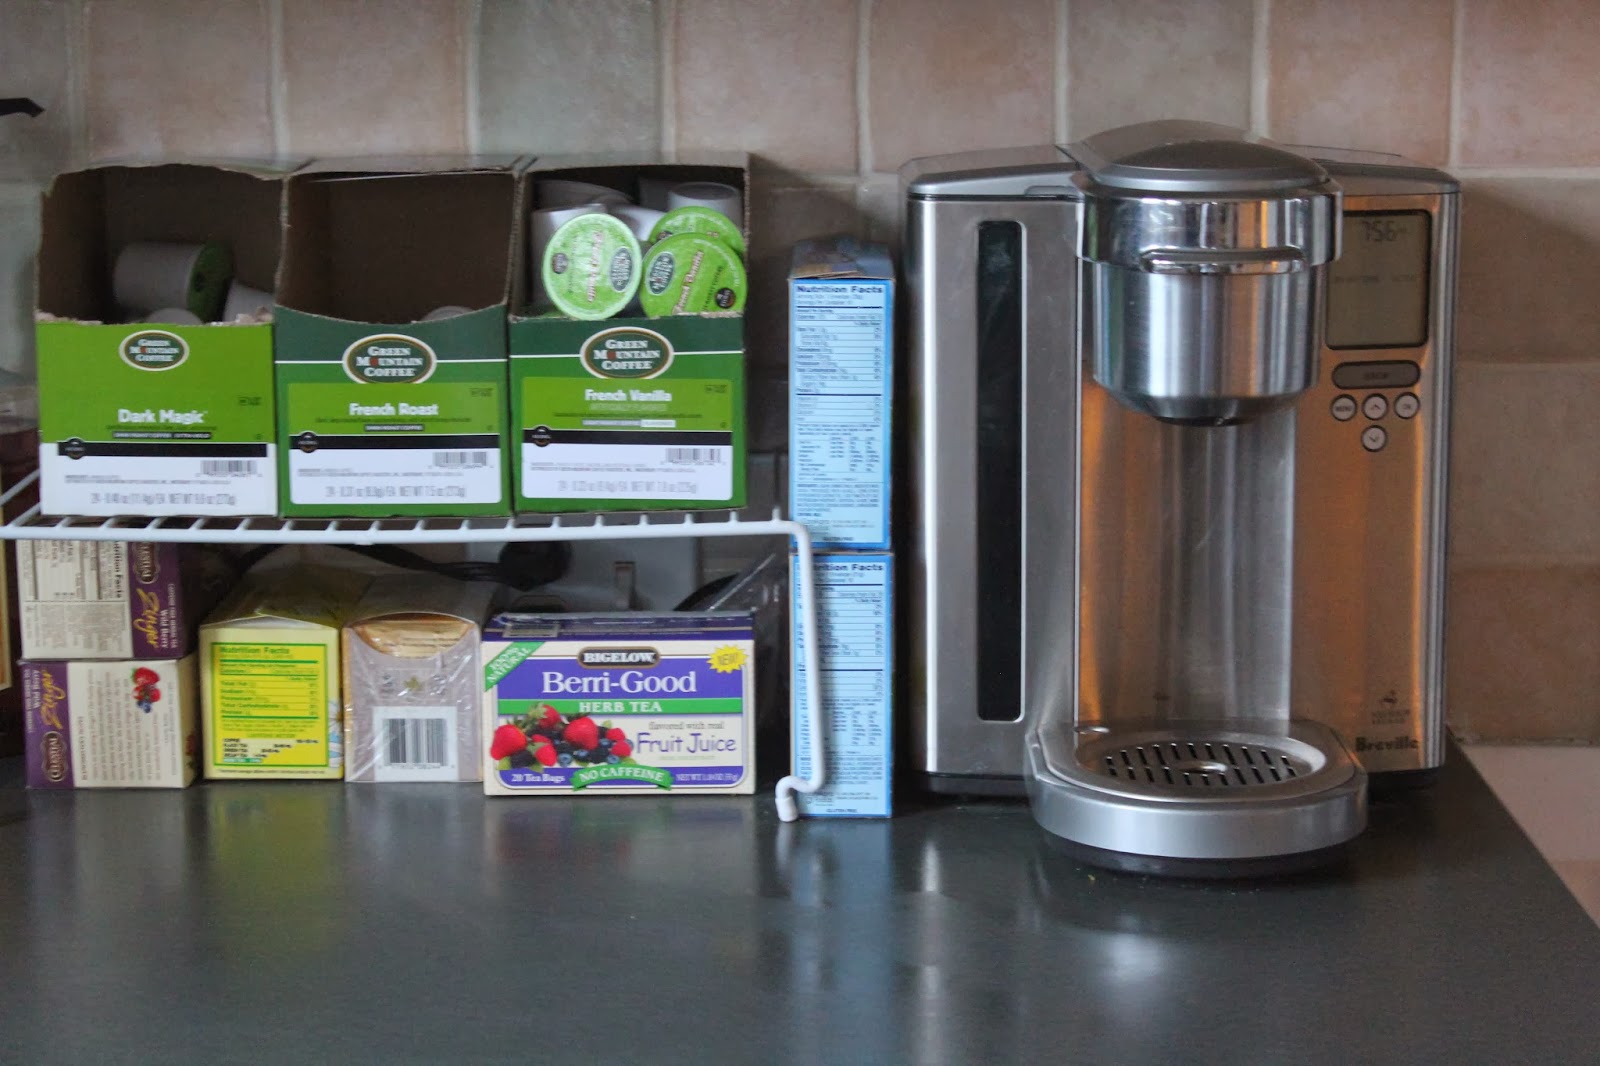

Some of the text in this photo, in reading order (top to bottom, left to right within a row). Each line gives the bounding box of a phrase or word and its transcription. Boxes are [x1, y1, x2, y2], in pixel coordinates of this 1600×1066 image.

[797, 285, 883, 293] Nutrition Facts
[605, 339, 648, 349] GREEN
[367, 346, 411, 356] GREEN
[593, 349, 660, 360] MOUNTAIN
[356, 356, 423, 367] MOUNTAIN
[601, 360, 653, 370] COFFEE
[363, 367, 416, 377] COFFEE
[584, 388, 673, 402] French Vanilla
[349, 402, 440, 416] French Roast
[117, 408, 205, 425] Dark Magic
[133, 588, 160, 649] Zinger
[160, 609, 169, 649] Wild Berry
[583, 652, 655, 663] BIGELOW
[541, 671, 697, 693] Berri-Good
[41, 667, 66, 729] Zinger
[579, 701, 663, 713] HERB TEA
[648, 721, 725, 730] flavored with real
[637, 732, 737, 753] Fruit Juice
[511, 773, 566, 783] 20 Tea Bags
[580, 767, 665, 782] NO CAFFEINE
